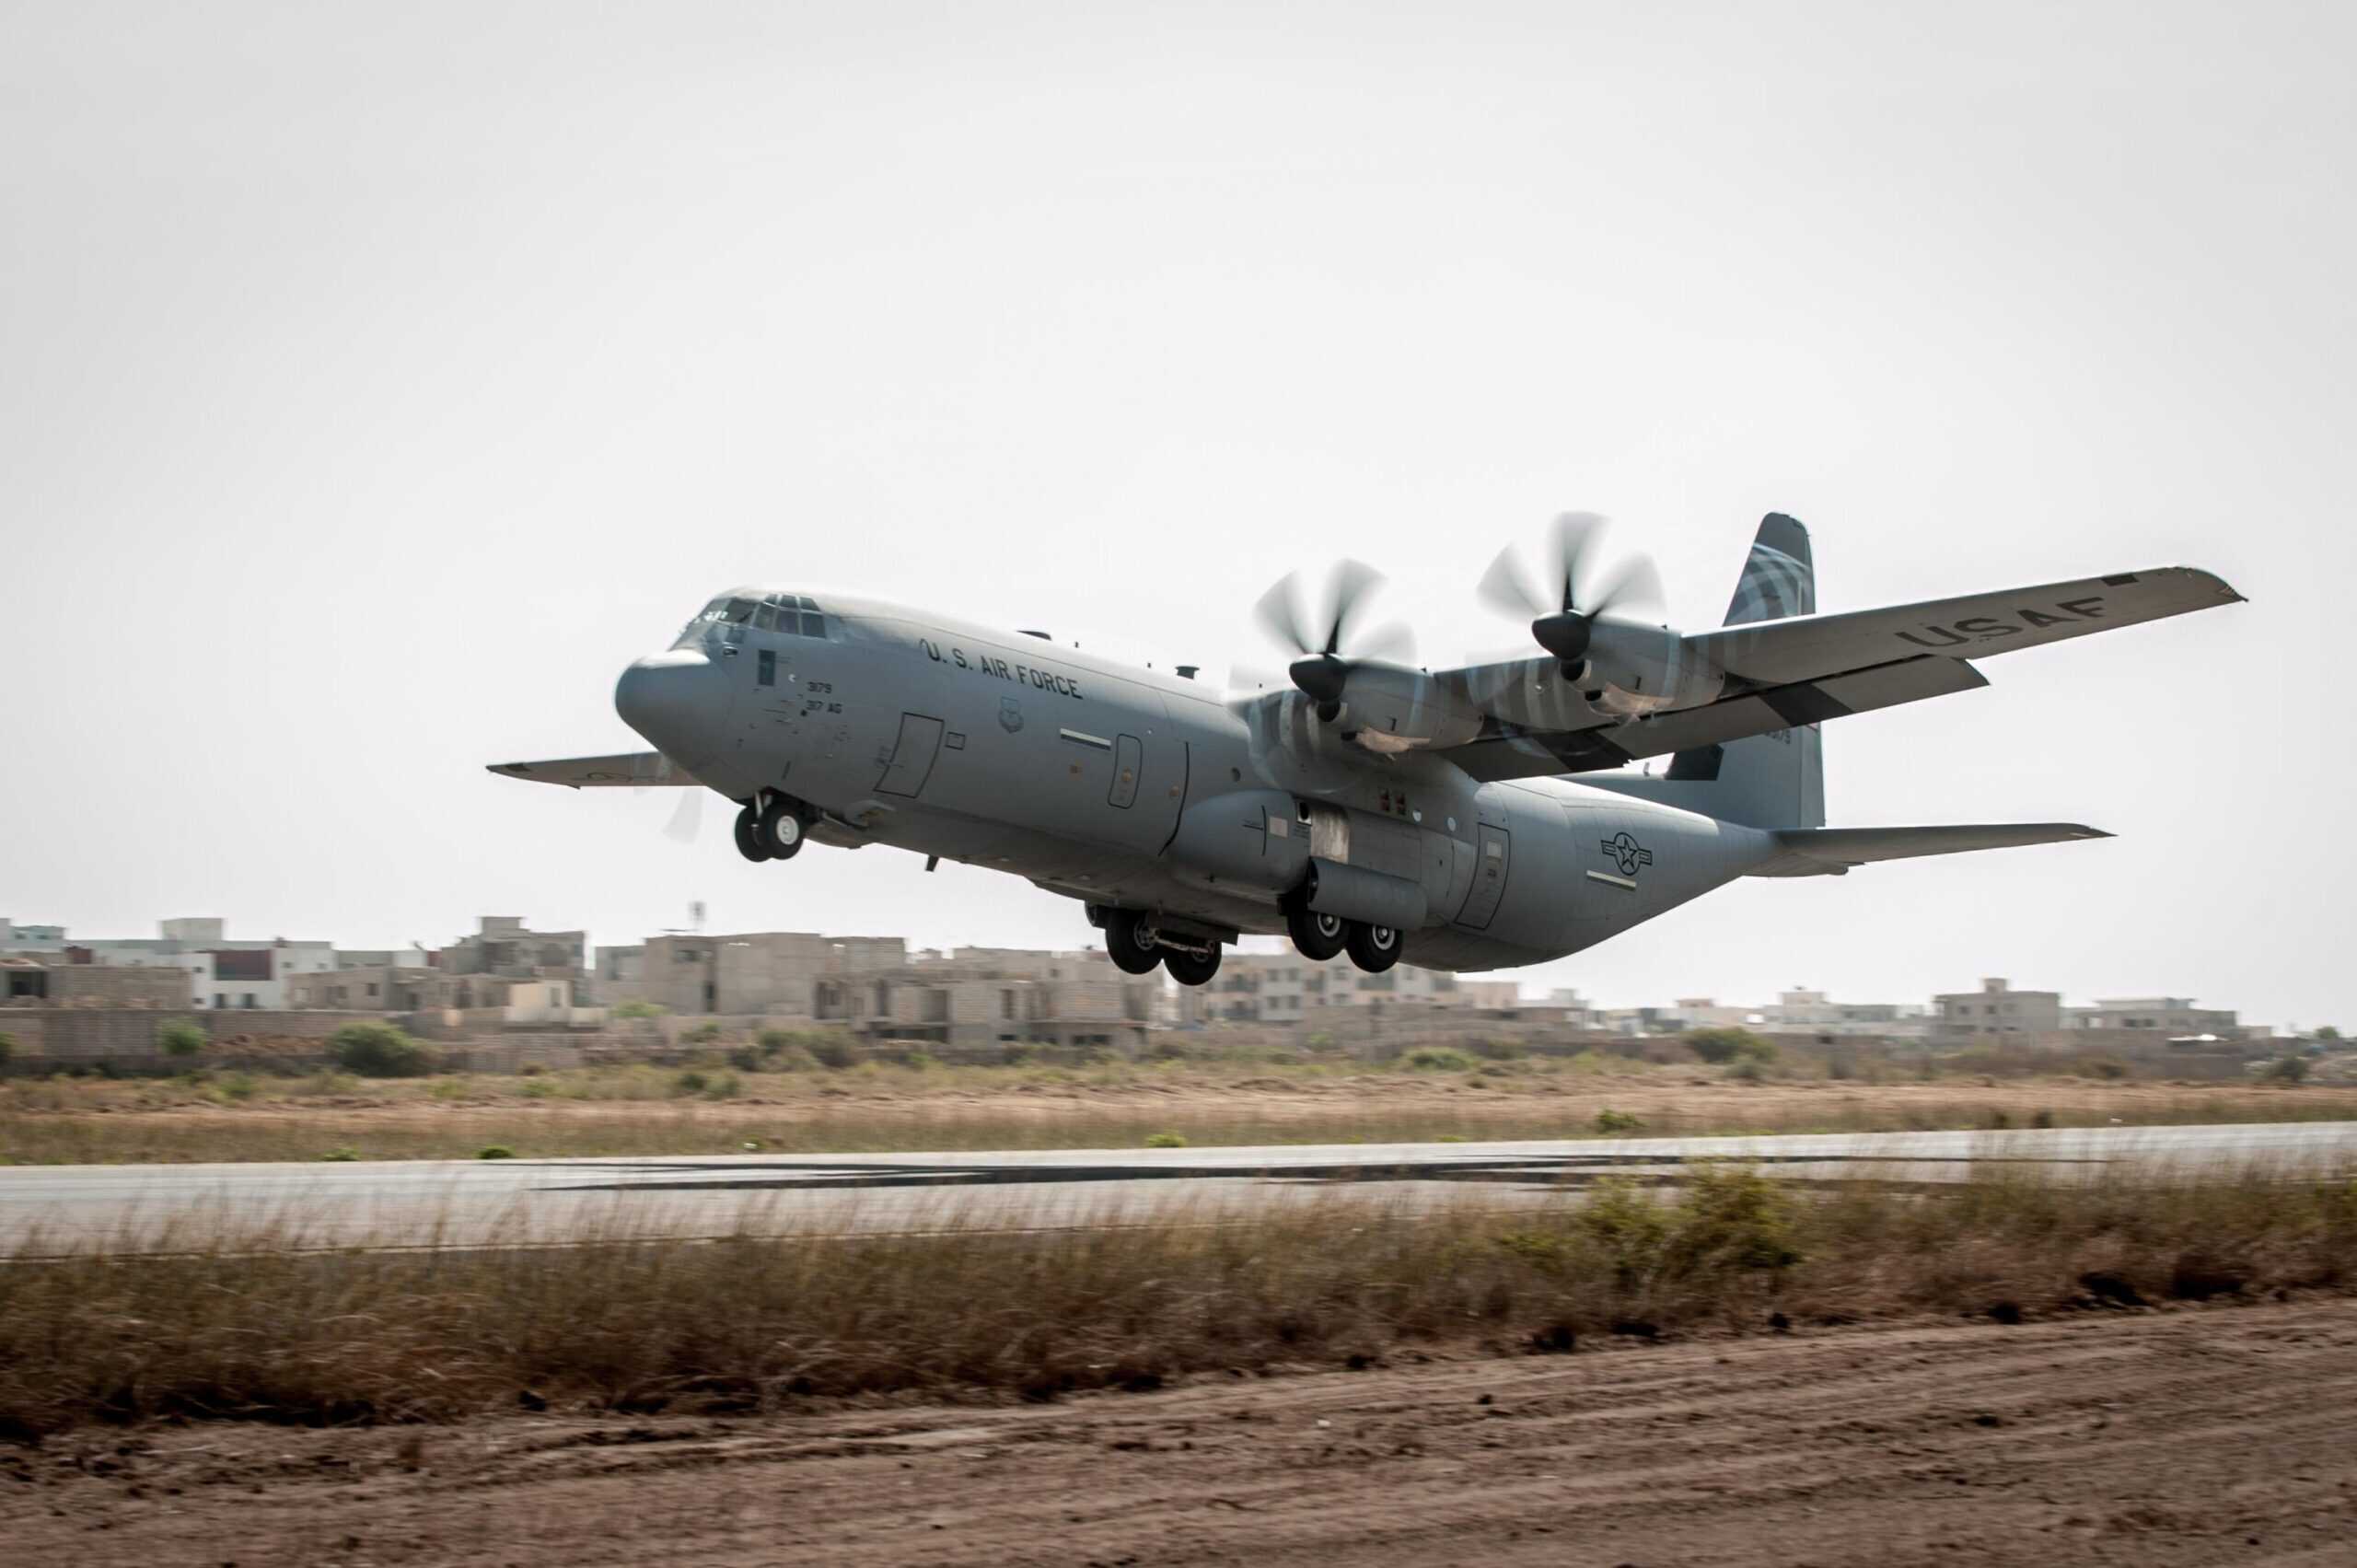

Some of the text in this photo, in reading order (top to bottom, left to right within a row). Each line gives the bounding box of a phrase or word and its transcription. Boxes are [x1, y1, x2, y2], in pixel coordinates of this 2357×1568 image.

[1895, 597, 2104, 647] USAF
[980, 655, 1012, 680] AIR
[1016, 664, 1083, 700] FORCE
